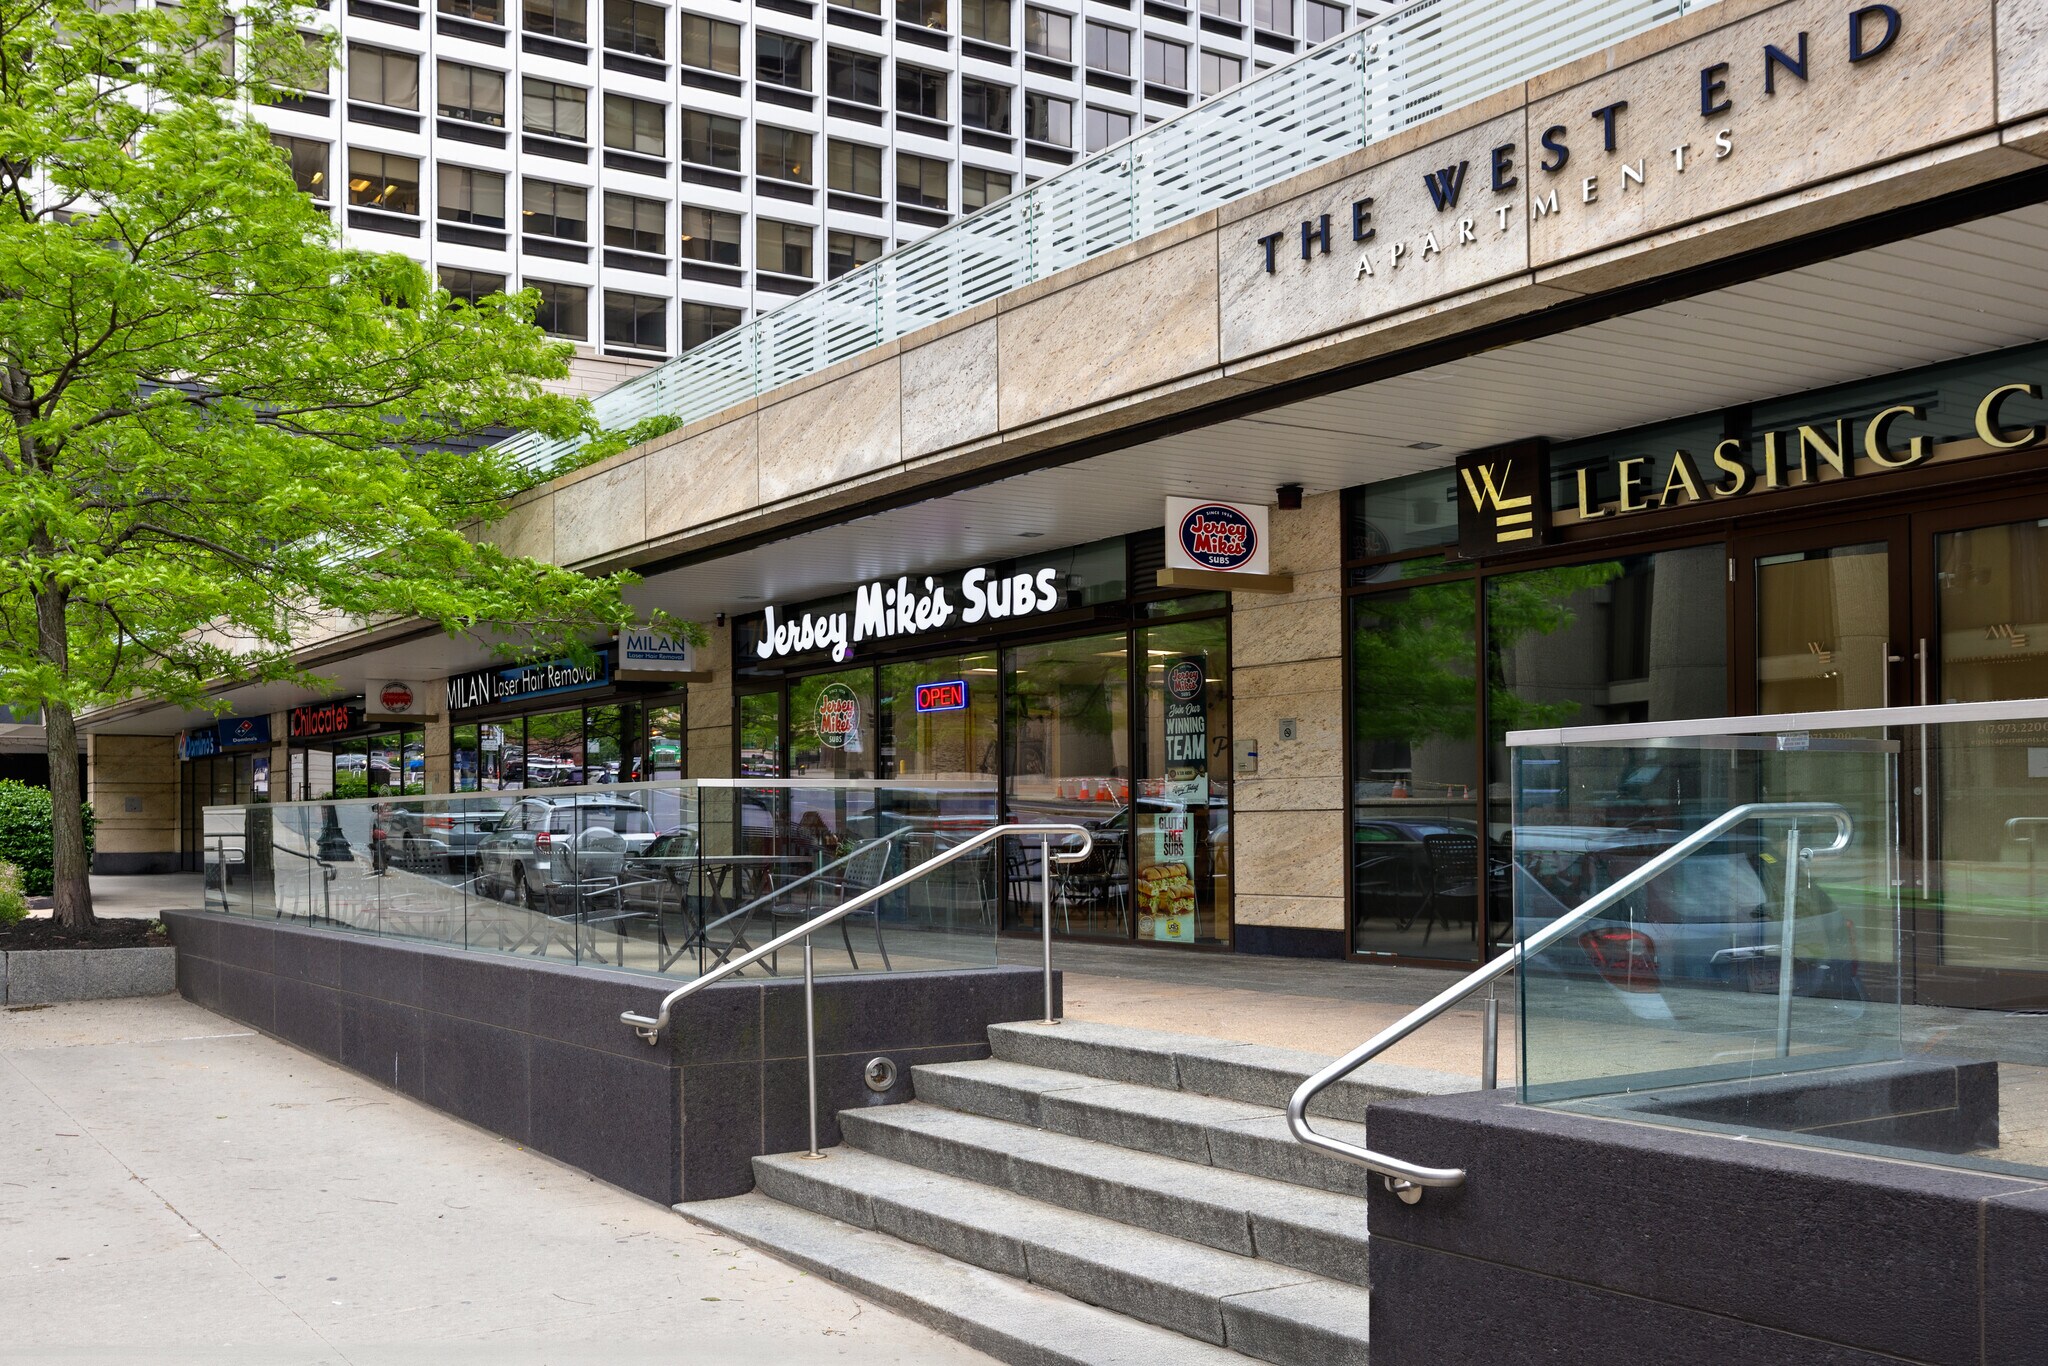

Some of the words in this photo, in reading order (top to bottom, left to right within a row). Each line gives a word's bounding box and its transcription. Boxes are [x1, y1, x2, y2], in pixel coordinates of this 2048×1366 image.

[1258, 197, 1377, 274] THE
[1422, 100, 1629, 213] WEST
[1700, 3, 1902, 117] END
[1354, 128, 1735, 280] APARTMENTS
[1576, 404, 1934, 520] LEASING
[1190, 514, 1247, 542] Jersey
[1193, 533, 1246, 556] Mike's
[1208, 556, 1230, 564] SUBS
[757, 605, 848, 663] Jersey
[853, 575, 954, 642] Mike's
[626, 635, 685, 652] MILAN
[446, 672, 490, 710] MILAN
[493, 675, 518, 697] Laser
[521, 666, 545, 692] Hair
[548, 657, 596, 689] Removal
[1172, 669, 1198, 684] Jersey
[819, 694, 854, 719] Jersey
[918, 684, 962, 709] OPEN
[293, 703, 348, 737] Chilacates
[820, 713, 853, 734] Mike's
[1166, 716, 1205, 735] WINNING
[829, 735, 842, 743] SUBS
[1166, 734, 1206, 761] TEAM
[1158, 816, 1188, 830] GLUTEN
[1164, 830, 1184, 843] FREE
[1163, 843, 1184, 856] SUBS
